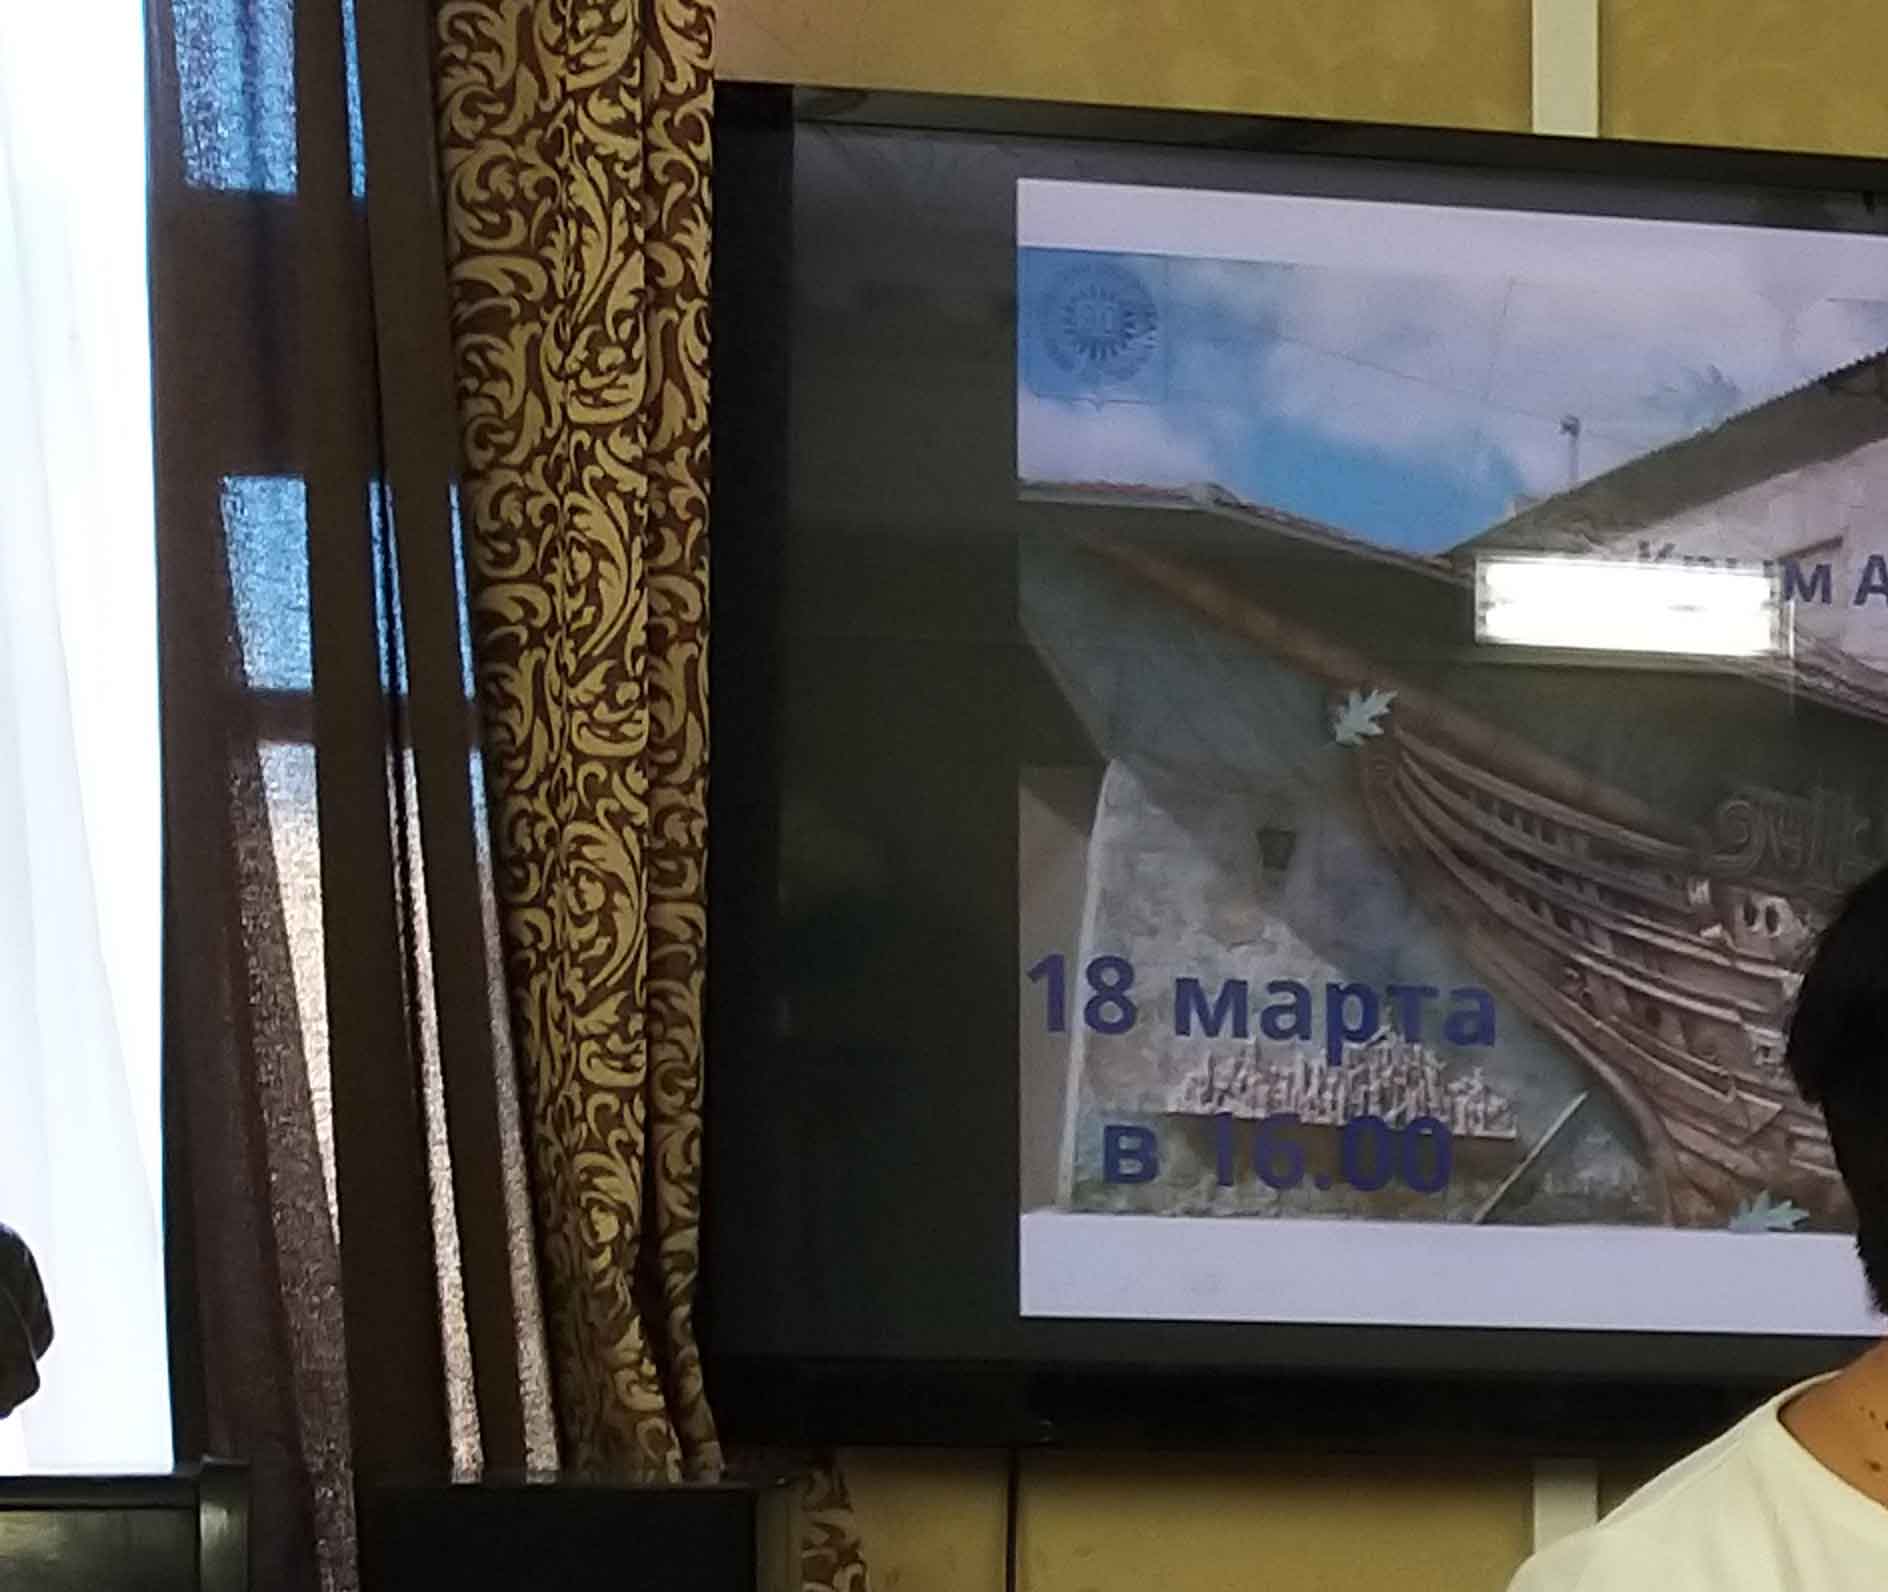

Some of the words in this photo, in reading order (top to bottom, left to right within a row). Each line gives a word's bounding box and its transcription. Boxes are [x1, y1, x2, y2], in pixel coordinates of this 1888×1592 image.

[1026, 953, 1138, 1036] 18
[1174, 976, 1497, 1066] марта
[1214, 1112, 1454, 1193] 16.00
